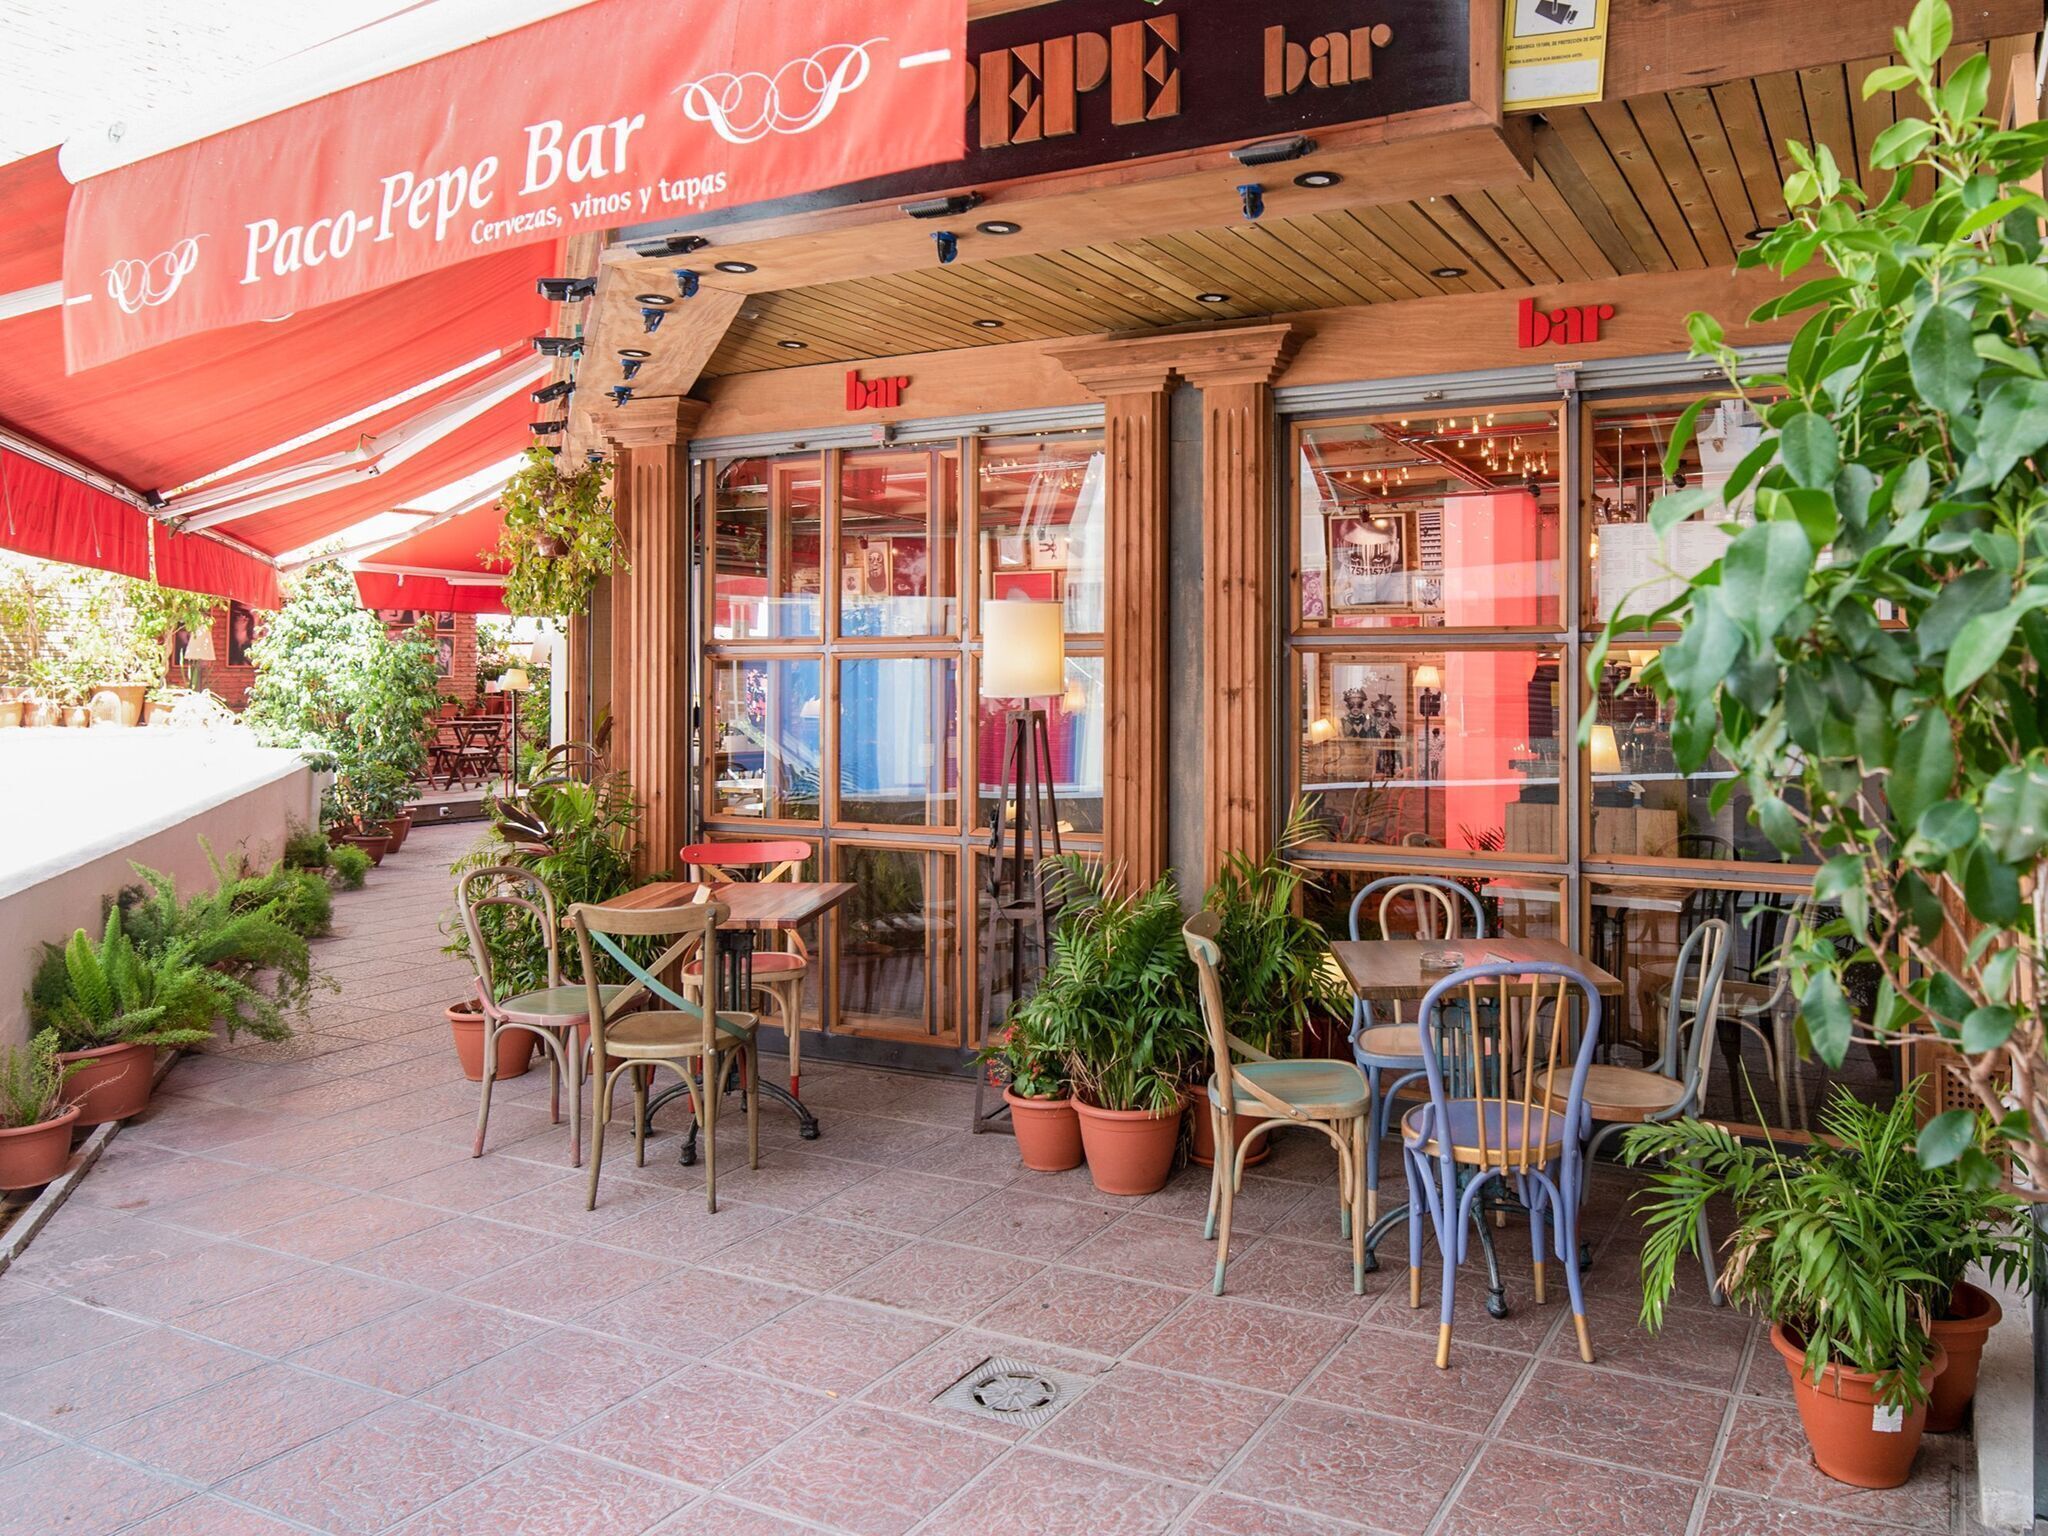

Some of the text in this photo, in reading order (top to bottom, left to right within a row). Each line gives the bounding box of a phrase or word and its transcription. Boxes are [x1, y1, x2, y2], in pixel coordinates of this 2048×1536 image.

[966, 13, 1394, 150] EPE bar
[240, 113, 646, 285] Paco-Pepe Bar
[470, 171, 728, 245] Cervezas, vinos y tapas
[1518, 297, 1616, 348] bar
[846, 369, 911, 411] bar
